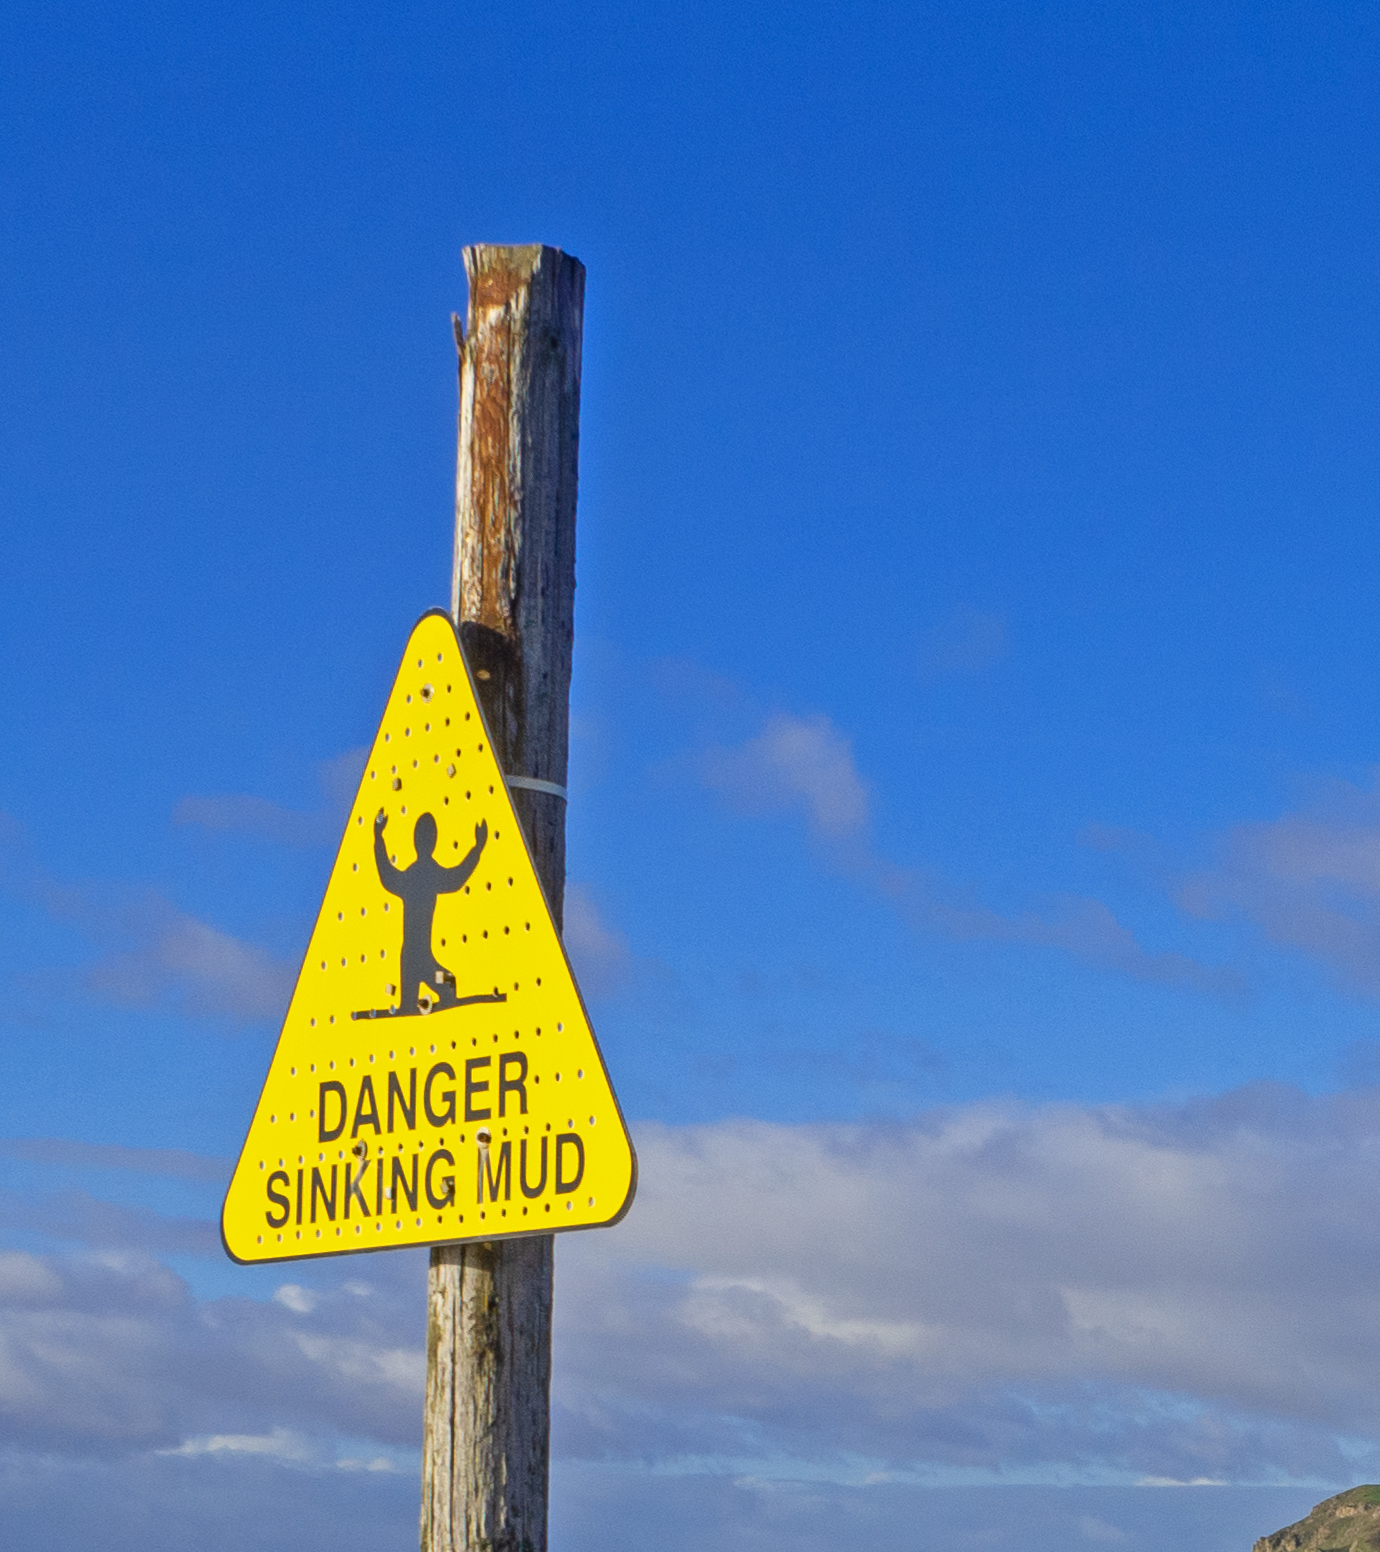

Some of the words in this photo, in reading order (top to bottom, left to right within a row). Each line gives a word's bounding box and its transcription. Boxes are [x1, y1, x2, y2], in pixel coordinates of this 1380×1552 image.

[318, 1051, 529, 1143] DANGER
[265, 1148, 456, 1229] SINKING
[477, 1132, 586, 1205] MUD
